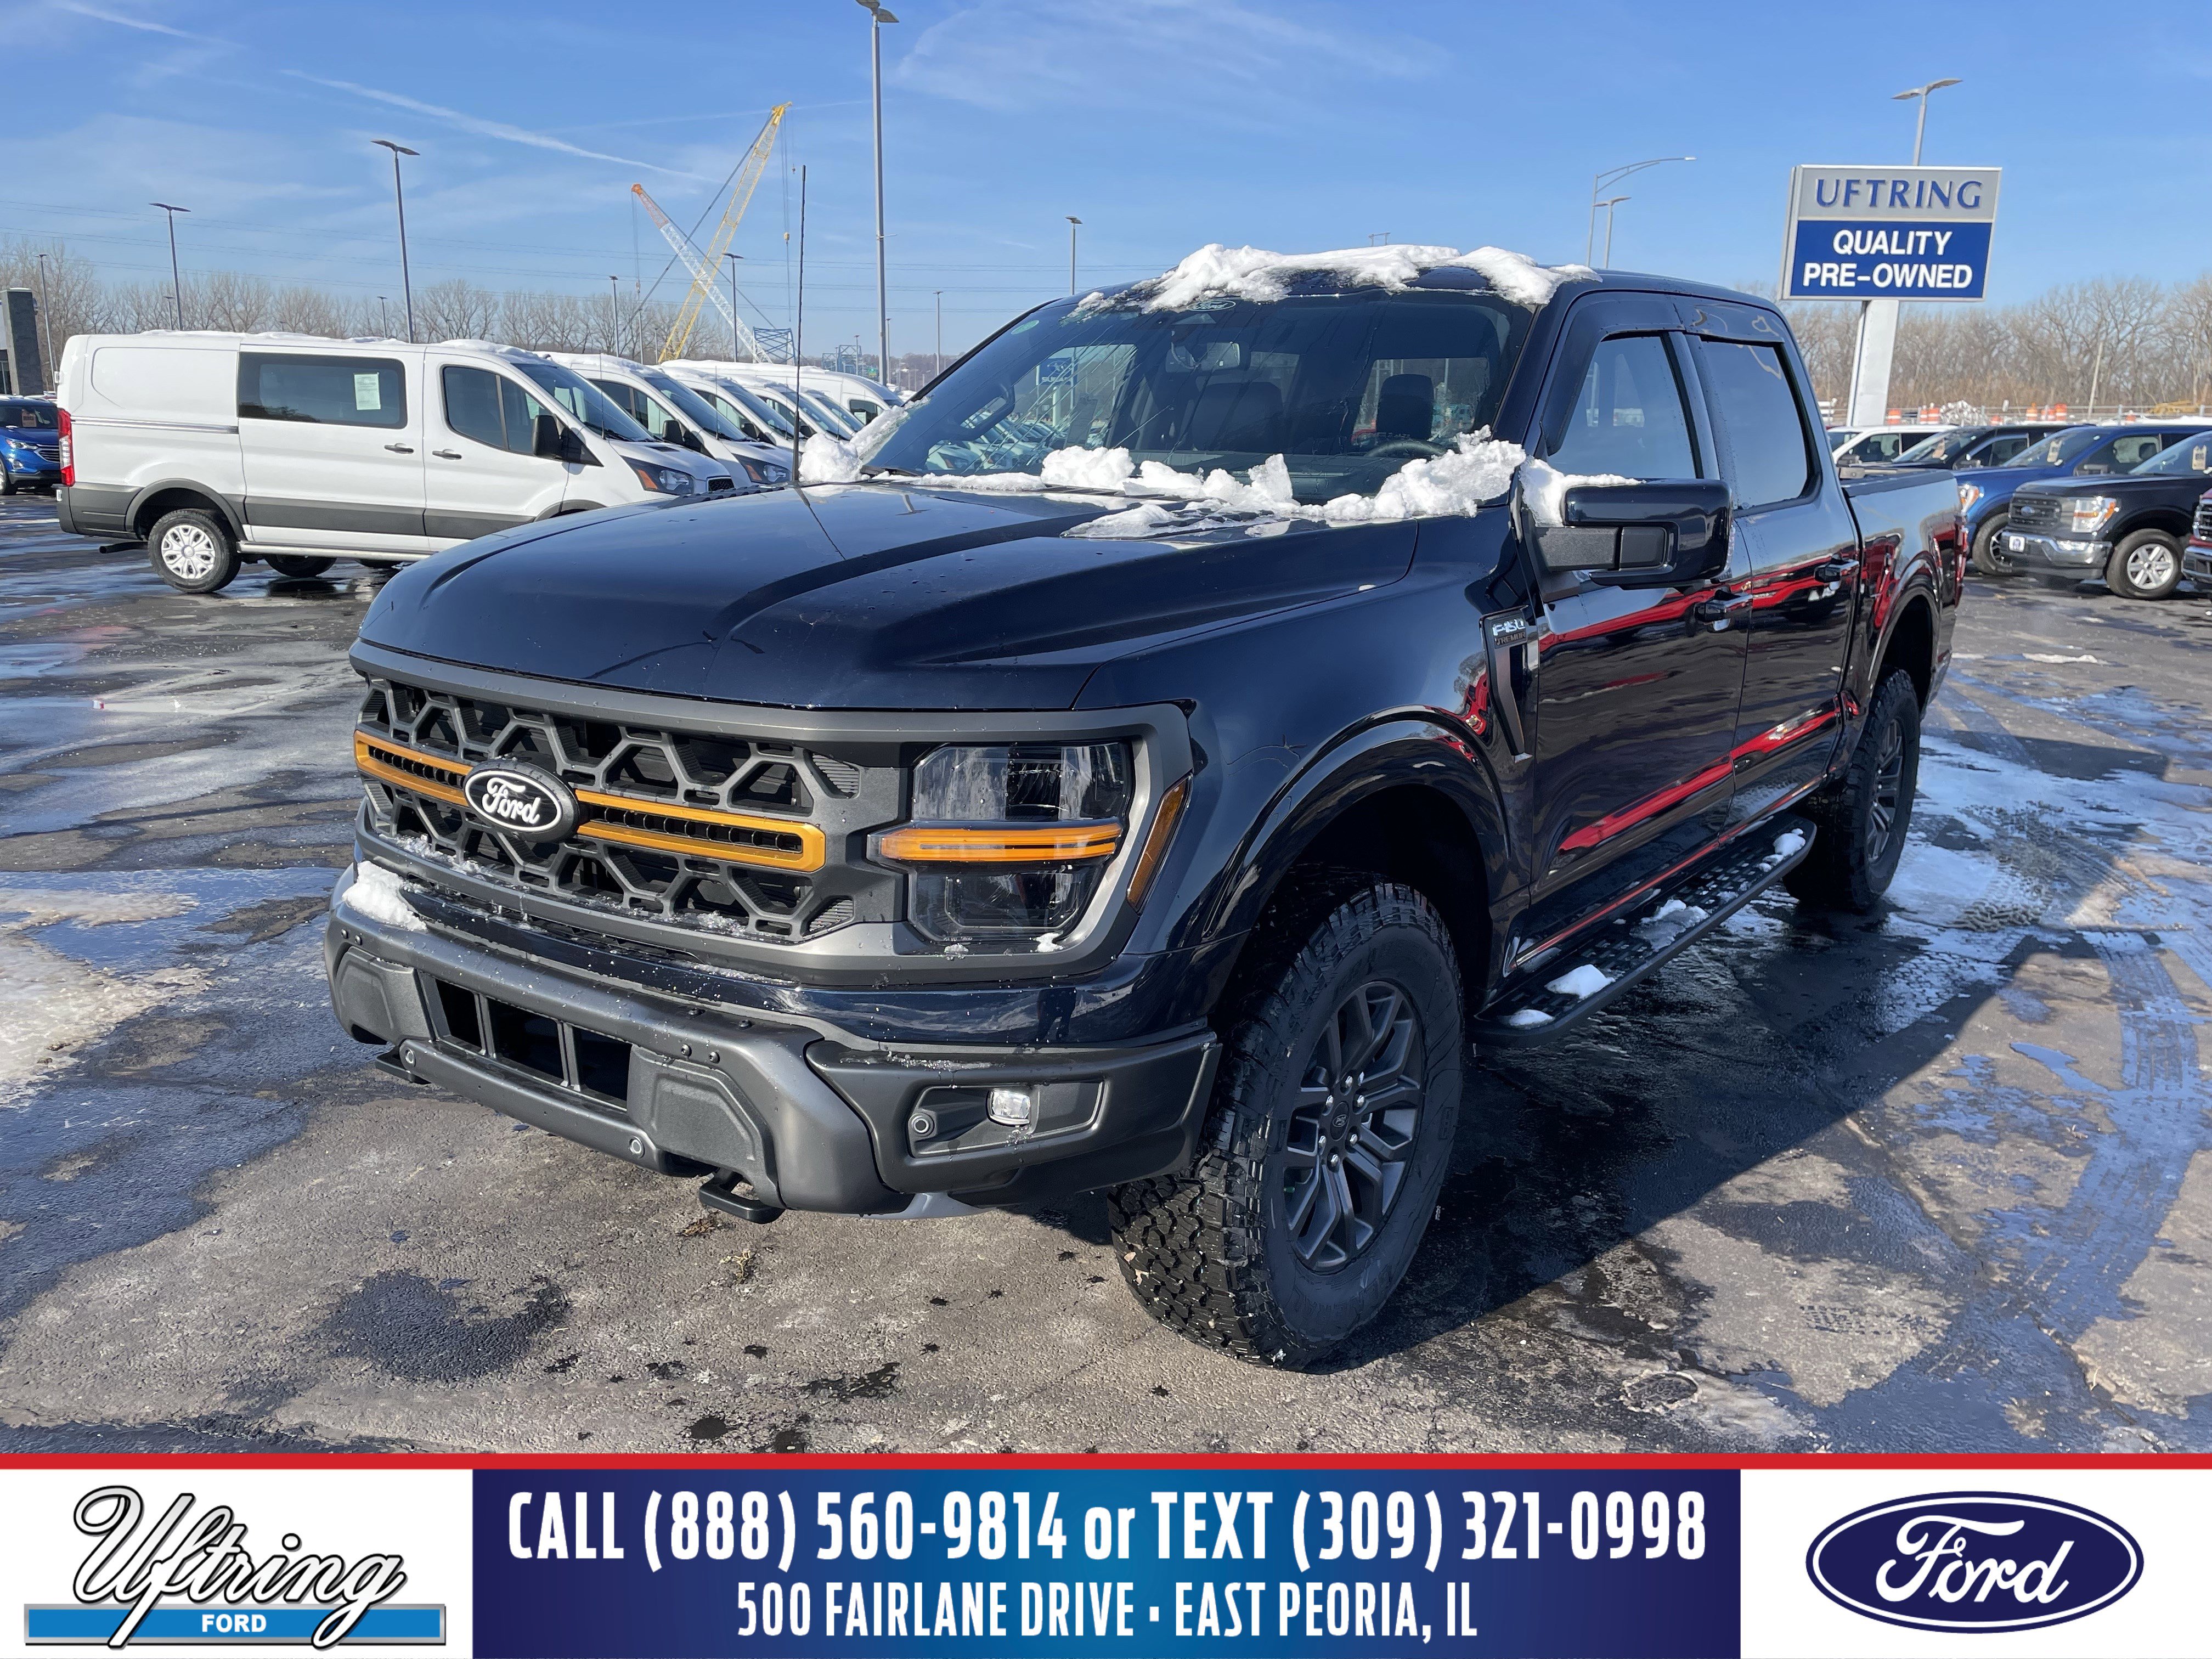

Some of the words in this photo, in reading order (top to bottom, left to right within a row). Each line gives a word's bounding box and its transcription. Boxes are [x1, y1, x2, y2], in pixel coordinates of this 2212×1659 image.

[1815, 178, 1983, 209] UFTRING
[1833, 229, 1953, 255] QUALITY
[1803, 262, 1973, 289] PRE-OWNED
[1494, 632, 1526, 646] TREMOR
[482, 777, 542, 824] Ford
